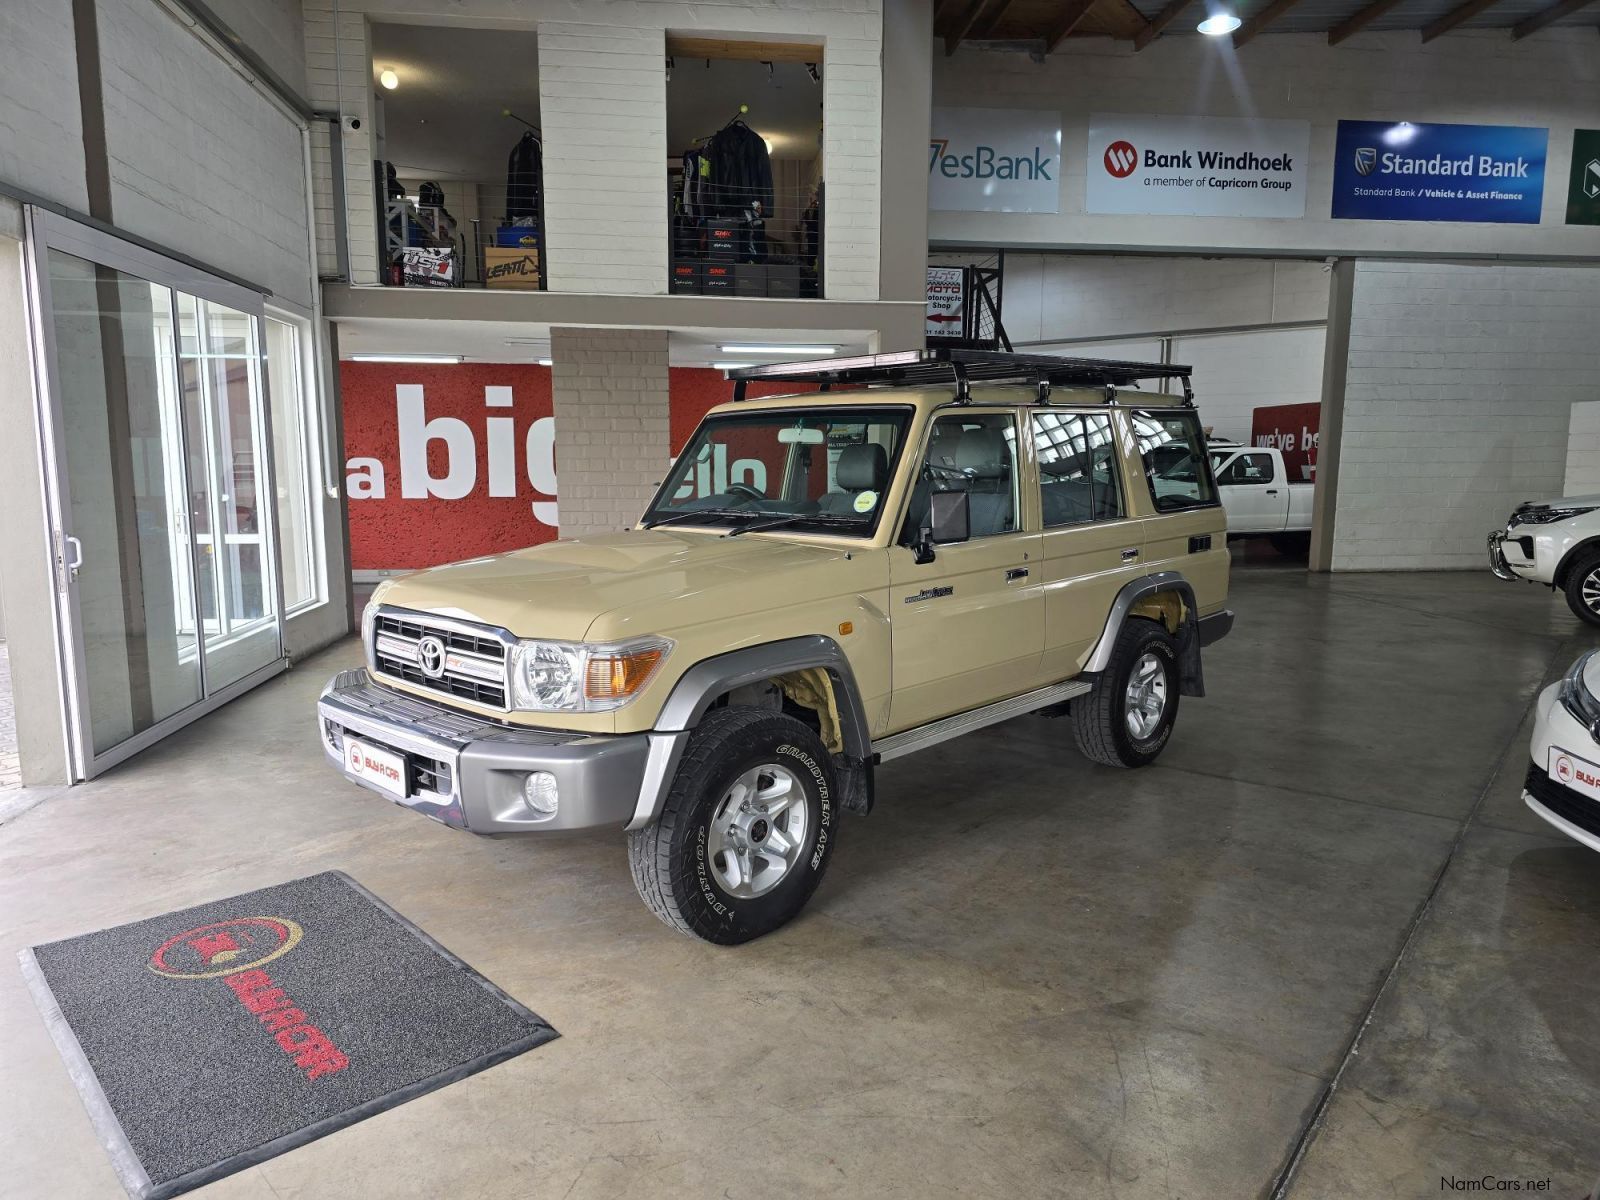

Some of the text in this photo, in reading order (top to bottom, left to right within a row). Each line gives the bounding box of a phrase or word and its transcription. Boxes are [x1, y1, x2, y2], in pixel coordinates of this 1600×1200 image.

[1144, 149, 1293, 172] Bank Windhoek
[1381, 153, 1529, 178] Standard Bank
[1144, 176, 1292, 191] a member of Capricorn Group
[1354, 187, 1393, 197] Standard
[1394, 188, 1416, 197] Bank
[1425, 189, 1456, 198] Vehicle
[1457, 190, 1464, 199] &
[1465, 190, 1489, 199] Asset
[1490, 191, 1523, 200] Finance
[932, 302, 951, 311] Shop
[1256, 427, 1295, 452] we've
[346, 457, 386, 499] a
[364, 757, 400, 782] BUY A CAR
[1575, 769, 1595, 787] BUY
[775, 744, 830, 827] GRANDTREK
[696, 825, 728, 915] DUNLOP
